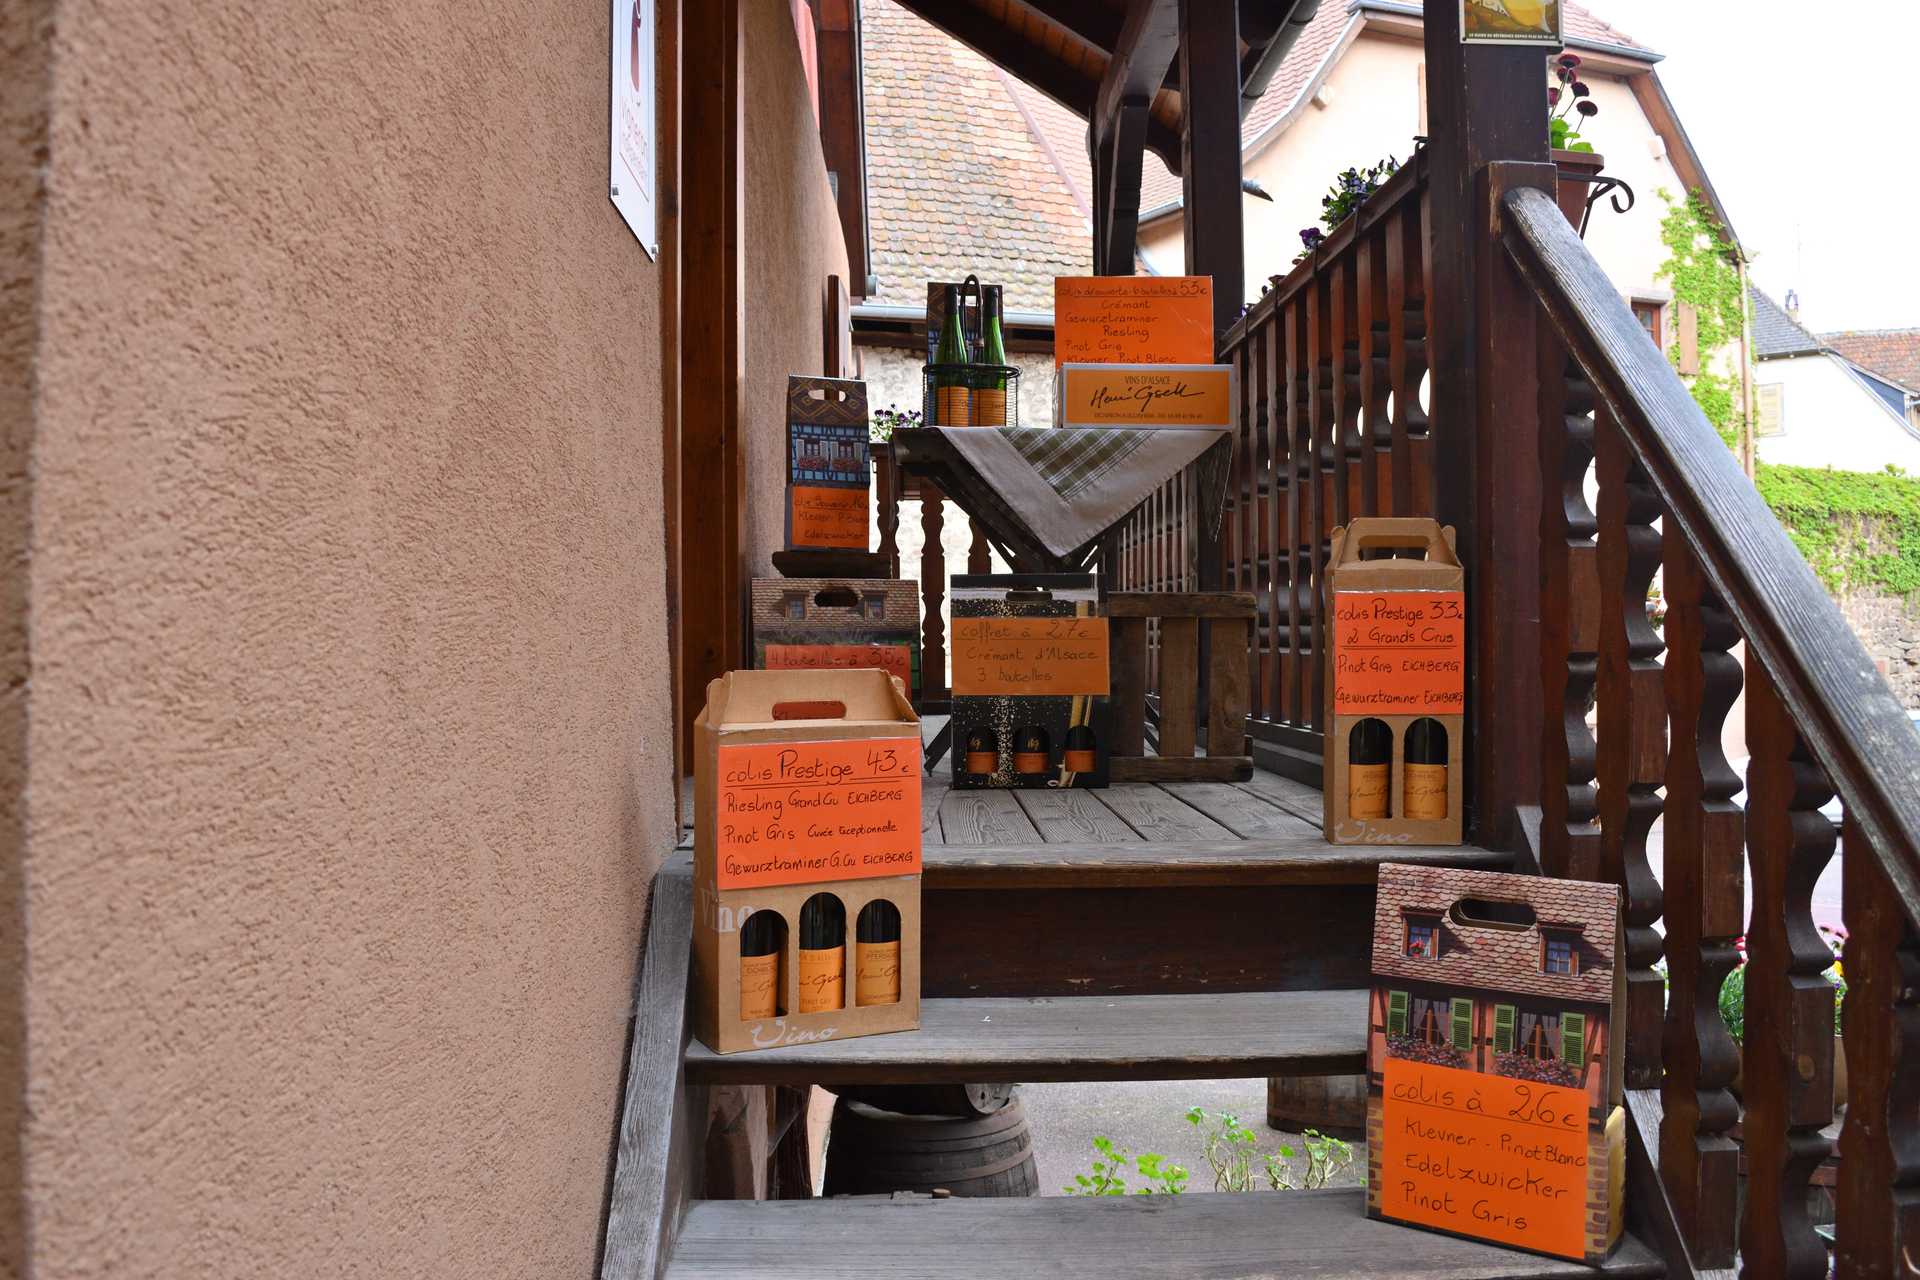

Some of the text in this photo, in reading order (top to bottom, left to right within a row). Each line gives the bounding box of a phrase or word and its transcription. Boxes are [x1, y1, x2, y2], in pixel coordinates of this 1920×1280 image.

[1102, 300, 1151, 310] Crémant
[1065, 339, 1122, 351] Pinot Gris
[1103, 324, 1150, 343] Riesling
[1337, 602, 1369, 620] colis
[1372, 598, 1424, 627] Prestige
[961, 621, 1011, 644] coffret
[1347, 626, 1454, 644] 2 Grands Crus
[966, 647, 1099, 660] Crémant d'Alsace
[1337, 654, 1367, 674] Pinot
[1369, 656, 1392, 673] Gris
[977, 668, 986, 682] 3
[1336, 687, 1420, 704] Gewurztraminer
[726, 760, 772, 782] colis
[777, 749, 853, 785] Prestige
[724, 792, 783, 820] Riesling
[788, 790, 820, 809] Grand
[848, 789, 903, 805] EICHBERG
[724, 824, 760, 844] Pinot
[766, 823, 796, 841] Gris
[725, 854, 829, 876] Gewurztraminer
[863, 850, 913, 866] EICHBERG
[751, 1016, 839, 1047] Vino
[1393, 1074, 1456, 1107] colis
[1466, 1091, 1484, 1113] à
[1405, 1116, 1587, 1167] Klevner Pinot Blanc
[1405, 1153, 1569, 1201] Edelzwicker
[1401, 1180, 1528, 1231] Pinot Gris
